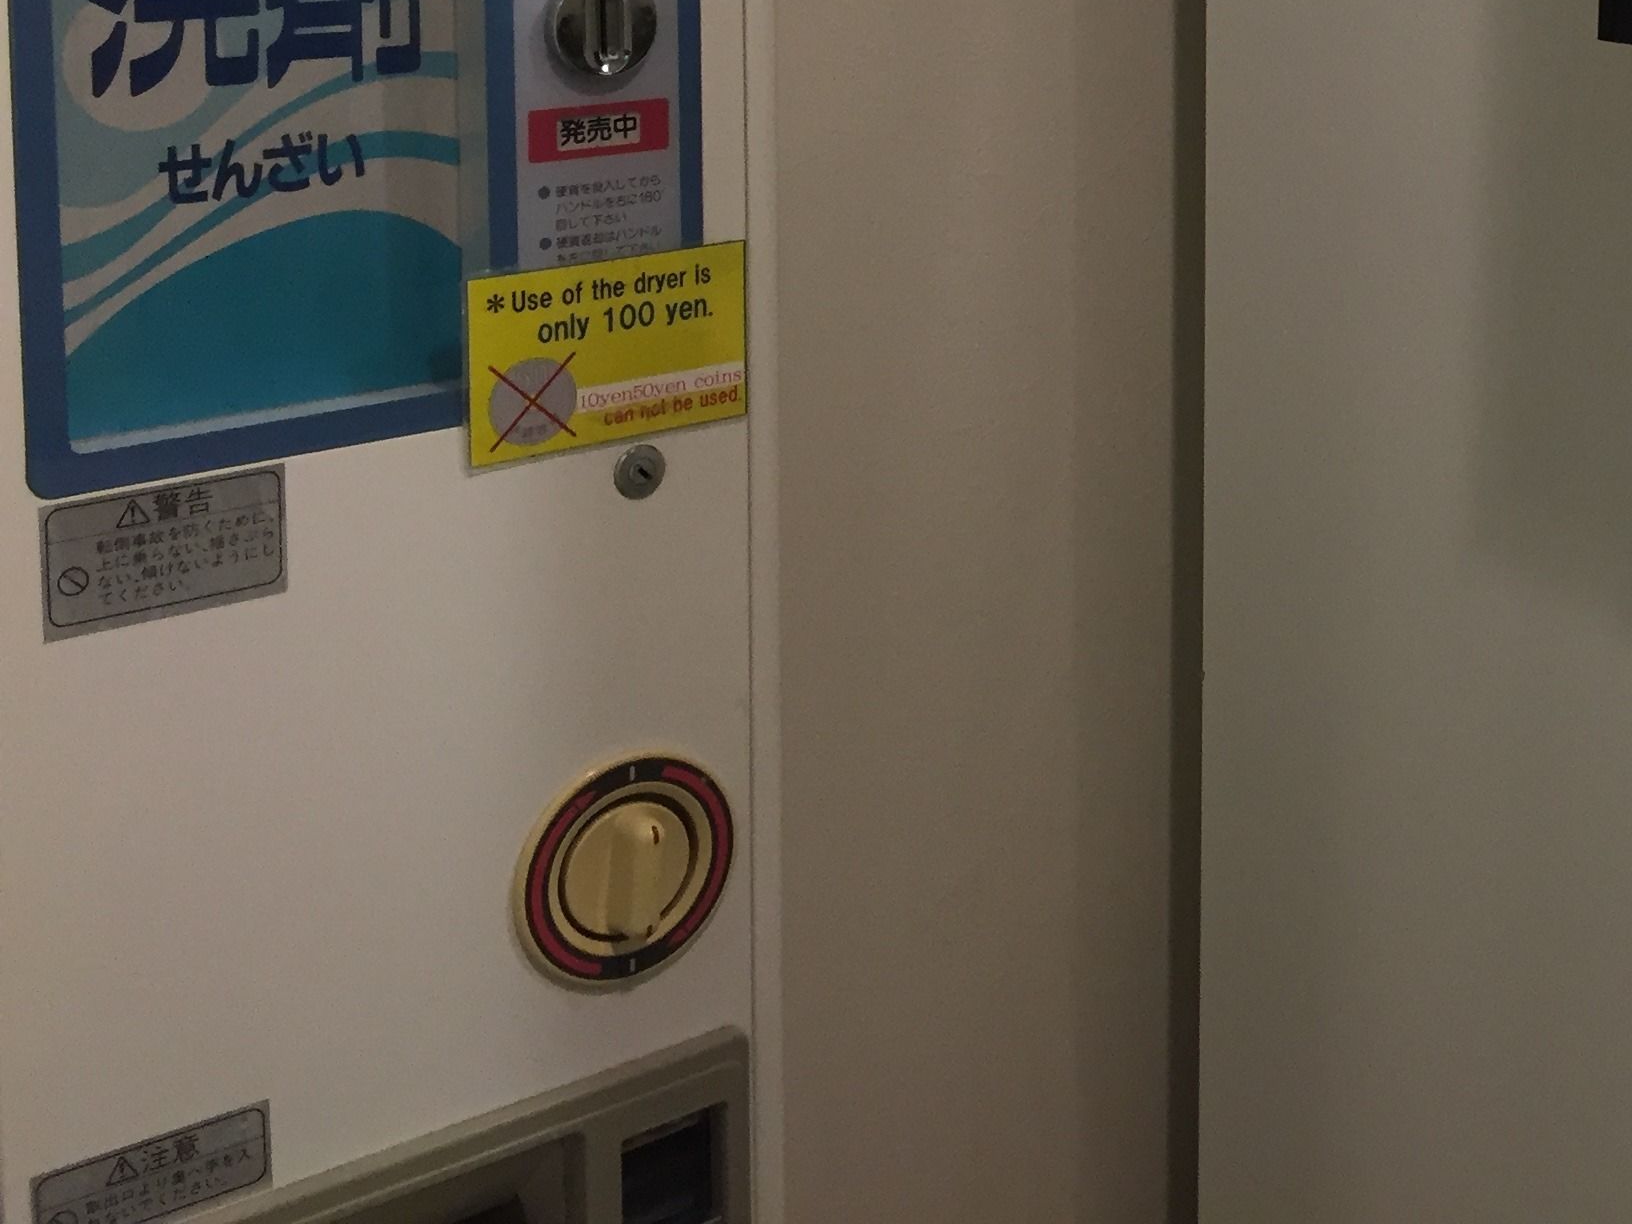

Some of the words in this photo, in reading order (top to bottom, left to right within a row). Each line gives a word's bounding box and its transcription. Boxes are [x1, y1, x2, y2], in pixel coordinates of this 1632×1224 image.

[560, 113, 639, 147] 発売中
[158, 131, 365, 205] せんざい
[511, 290, 553, 313] Use
[562, 281, 583, 305] of
[591, 278, 625, 300] the
[634, 271, 687, 294] dryer
[694, 263, 711, 285] is
[538, 313, 590, 343] only
[603, 301, 655, 333] 100
[665, 298, 714, 326] yen.
[693, 369, 742, 389] coins
[603, 409, 634, 426] can
[673, 395, 694, 413] be
[151, 487, 214, 522] 警告
[142, 1133, 200, 1174] 注意
